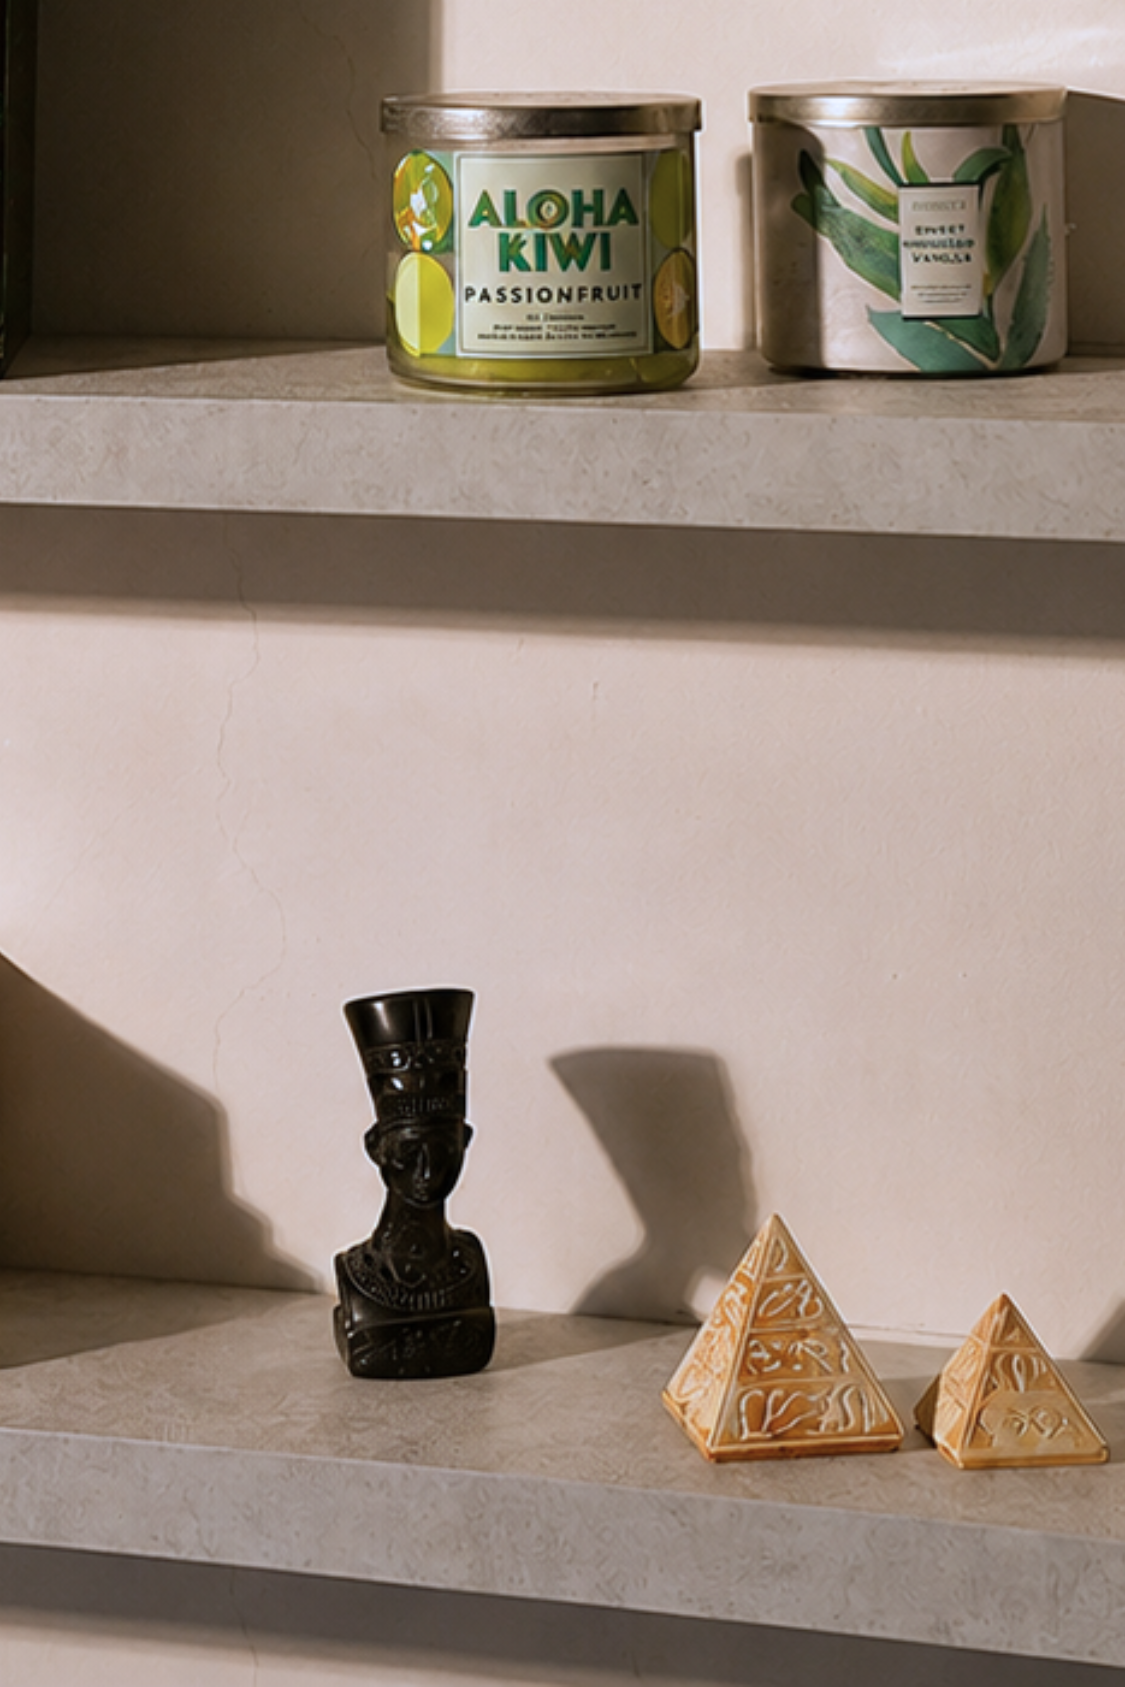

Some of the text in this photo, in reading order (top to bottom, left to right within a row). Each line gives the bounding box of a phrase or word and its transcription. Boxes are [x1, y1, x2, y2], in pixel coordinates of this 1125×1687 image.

[468, 188, 639, 229] ALOHA
[499, 232, 611, 272] KIWI
[465, 283, 642, 303] PASSIONFRUIT
